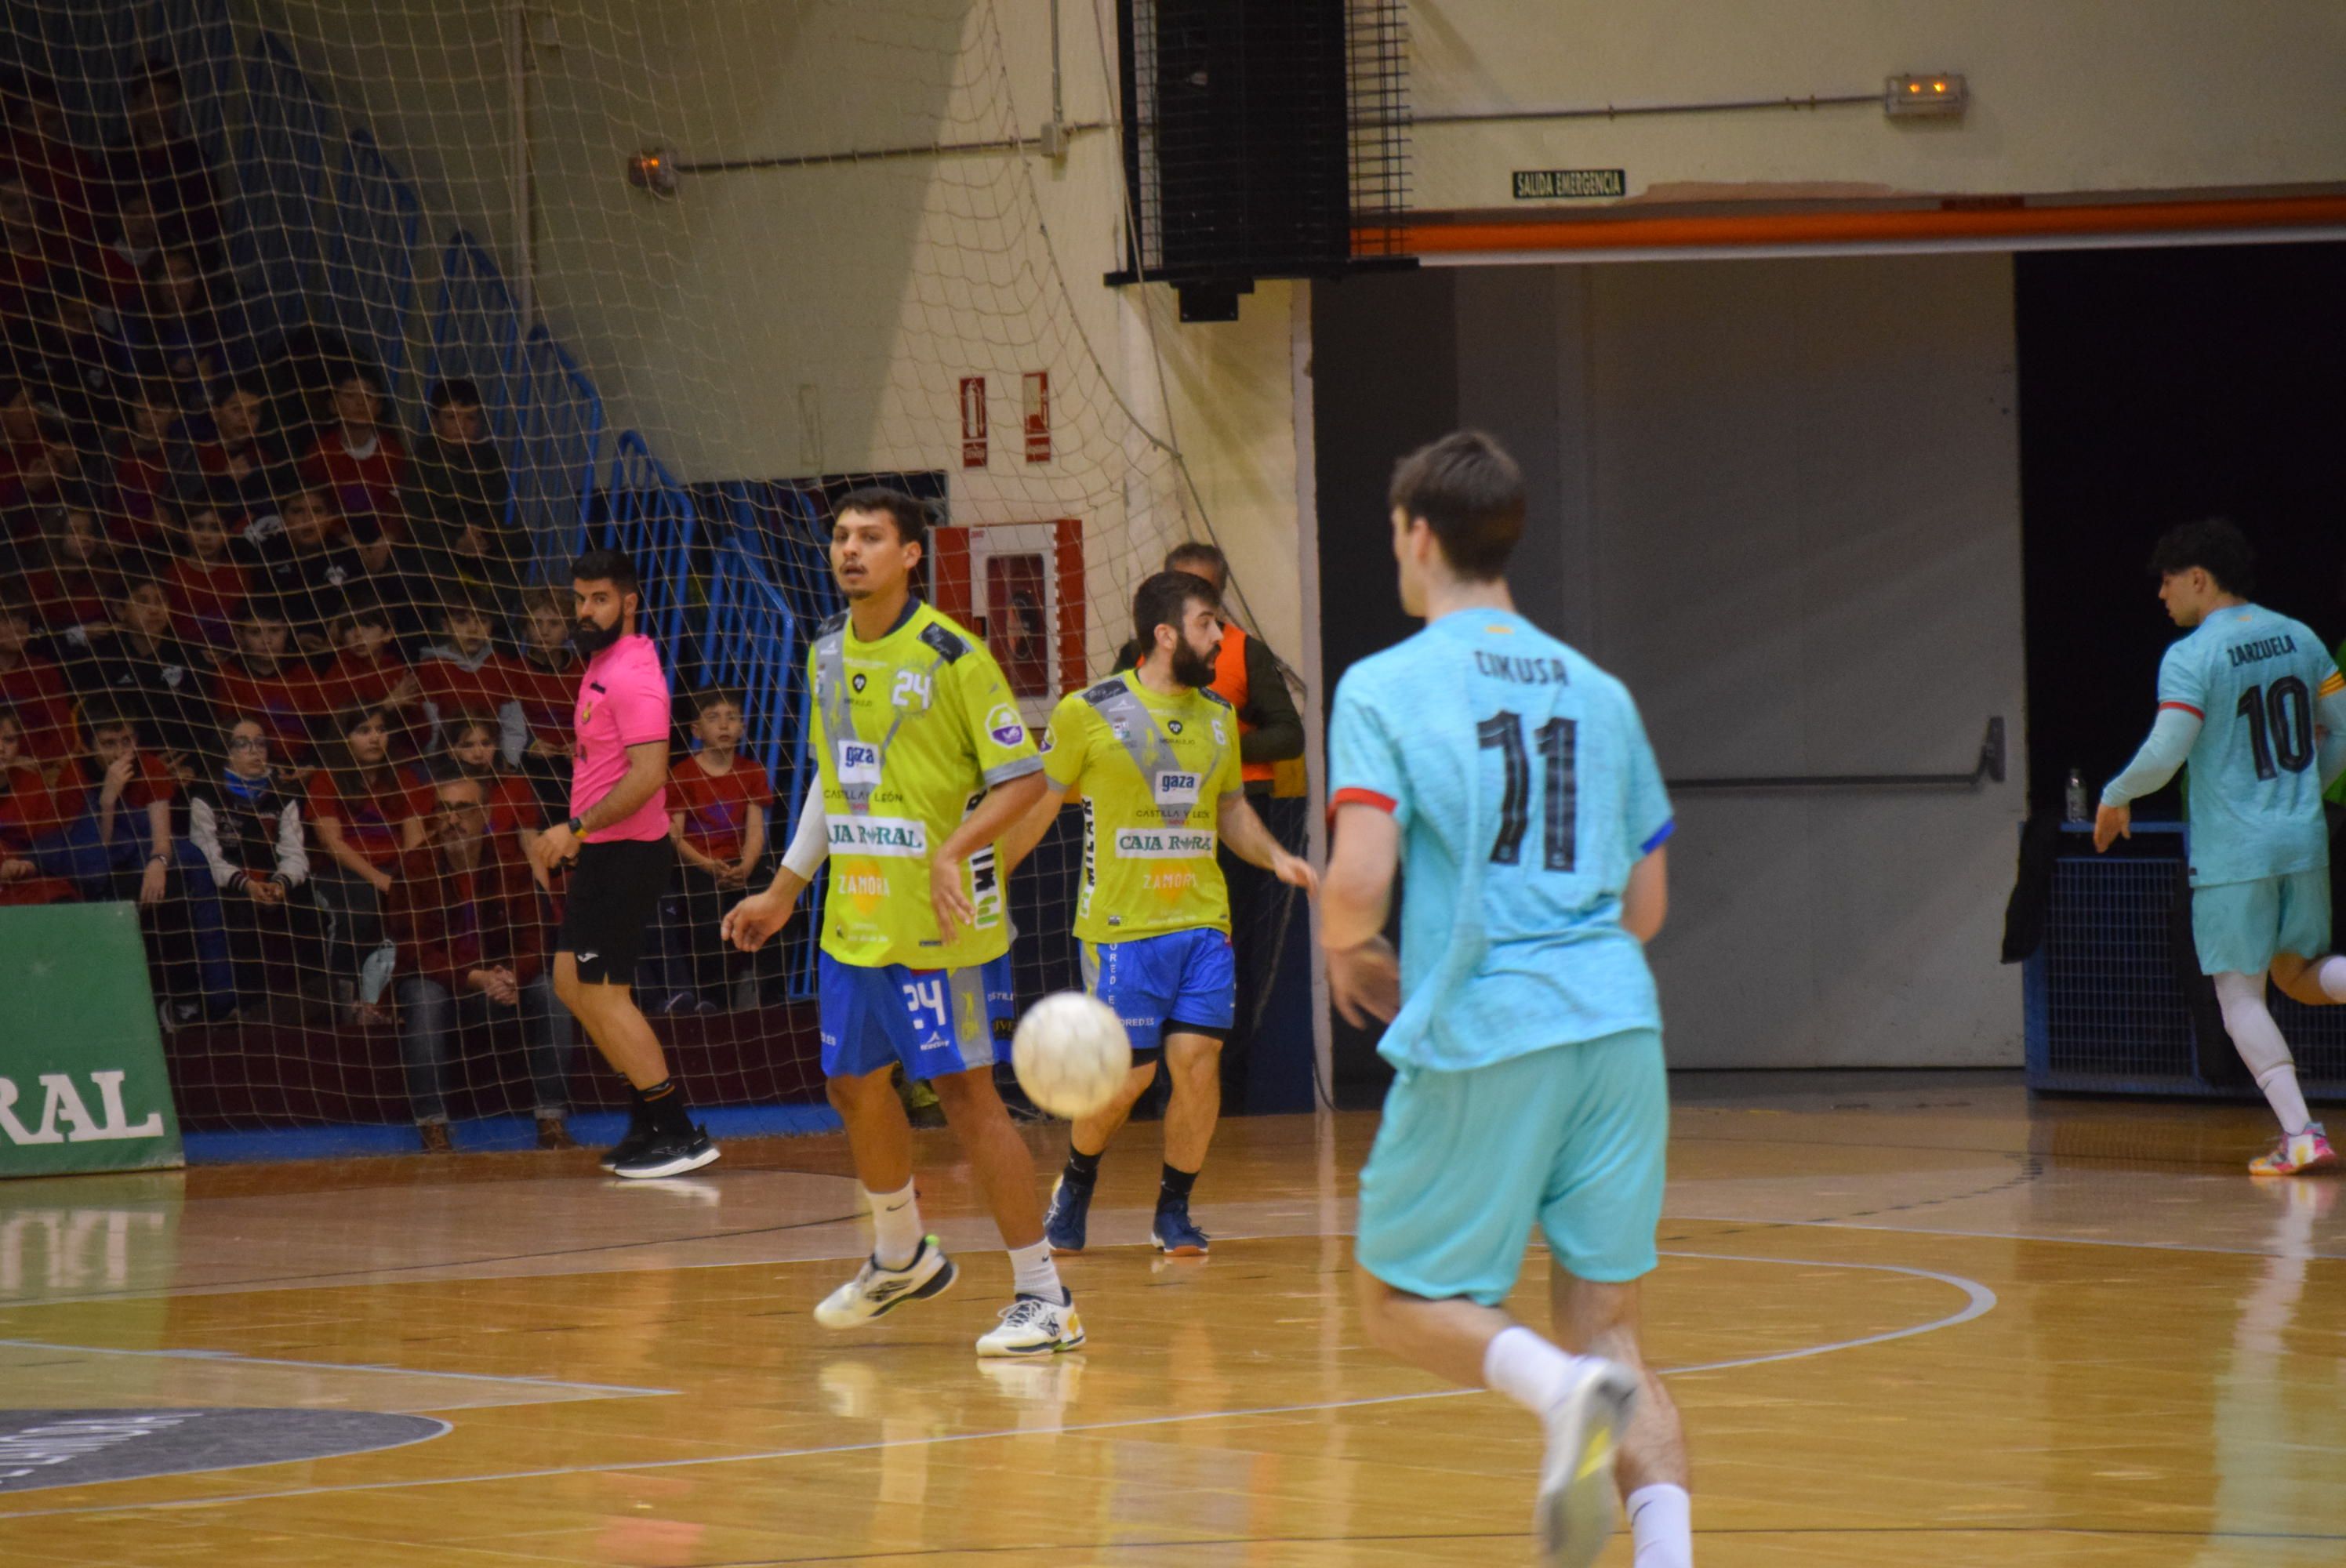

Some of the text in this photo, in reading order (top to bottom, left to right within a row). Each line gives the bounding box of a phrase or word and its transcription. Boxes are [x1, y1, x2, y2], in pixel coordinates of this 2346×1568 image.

[1517, 170, 1621, 196] SALIDA EMERGENCIA
[2227, 634, 2297, 667] ZARZUELA
[892, 669, 932, 710] 24
[1211, 719, 1226, 745] 6
[2236, 675, 2315, 782] 10
[846, 746, 874, 767] gaza
[1162, 775, 1195, 792] gaza
[1476, 710, 1578, 873] 11
[1135, 809, 1179, 818] CASTILLA
[1082, 797, 1095, 887] MILAR
[1119, 836, 1164, 851] CAJA
[838, 874, 891, 898] ZAMORA
